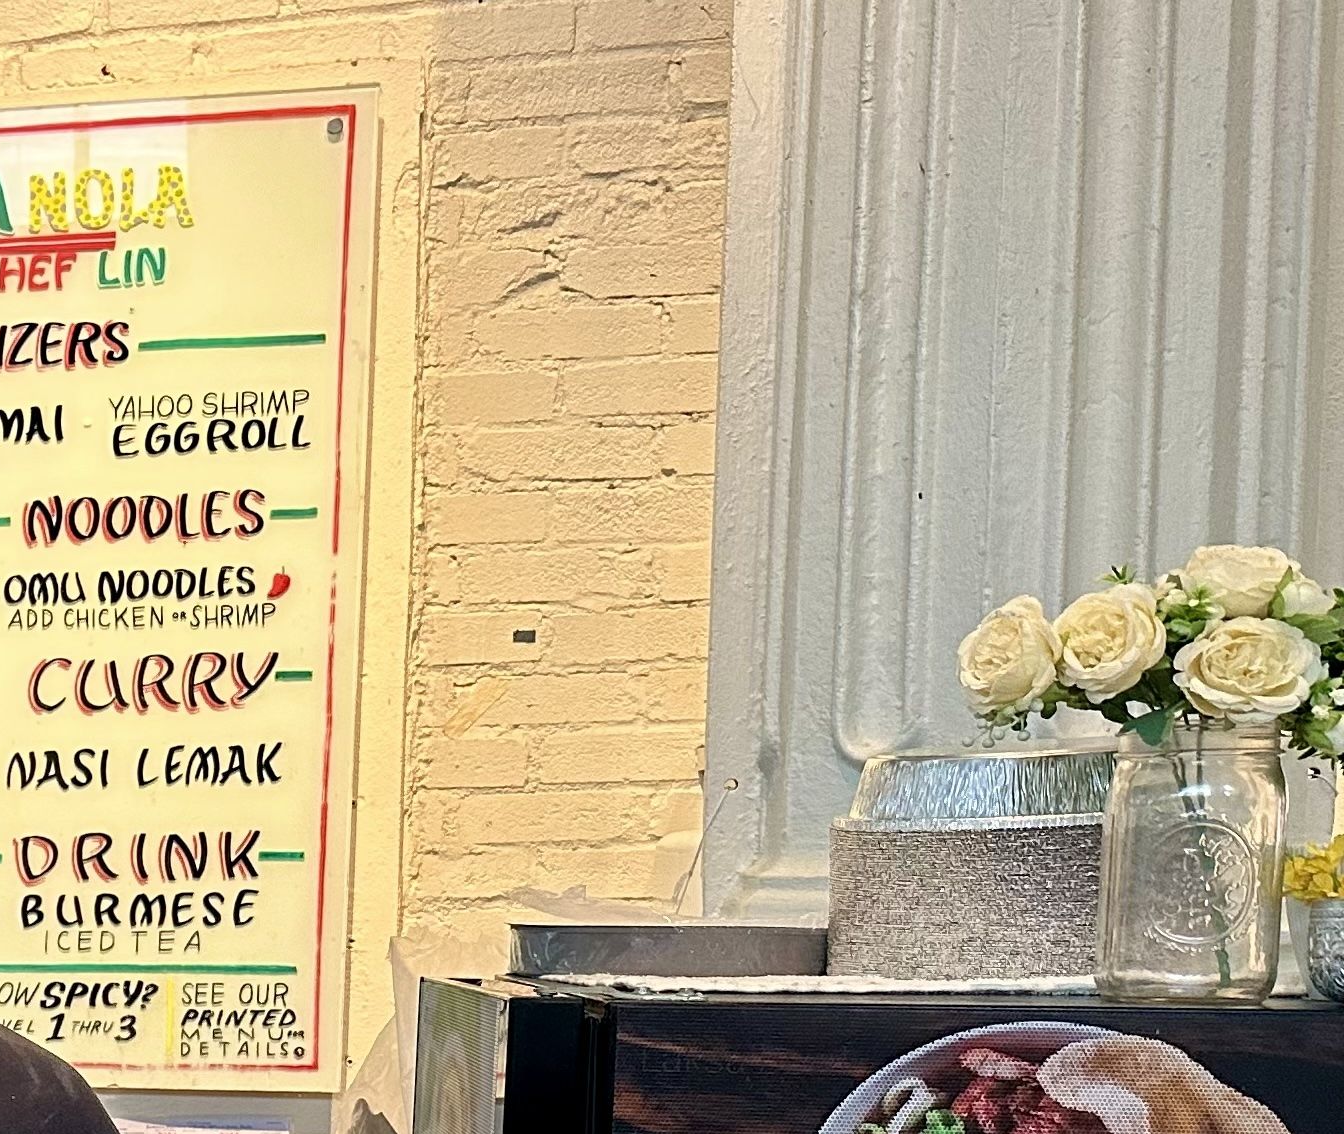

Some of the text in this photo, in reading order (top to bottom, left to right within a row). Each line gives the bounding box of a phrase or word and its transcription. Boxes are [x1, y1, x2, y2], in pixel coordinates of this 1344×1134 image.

[28, 163, 195, 232] NOLA
[97, 247, 167, 289] LIN
[108, 389, 309, 420] YAHOO SHRIMP
[24, 489, 267, 546] NOODLES
[3, 565, 256, 609] OMU NOODLES
[8, 608, 54, 631] ADD
[63, 605, 165, 631] CHICKEN
[189, 603, 278, 629] SHRIMP
[29, 651, 279, 715] CURRY
[6, 741, 283, 792] NASI LEMAK
[11, 829, 263, 887] DRINK
[20, 889, 260, 930] BURMESE
[43, 929, 202, 955] ICED TEA
[40, 980, 158, 1010] SPICY?
[181, 982, 289, 1007] SEE OUR
[45, 1012, 137, 1042] 1 THRU 3
[181, 1009, 297, 1028] PRINTED
[181, 1028, 284, 1041] MENU
